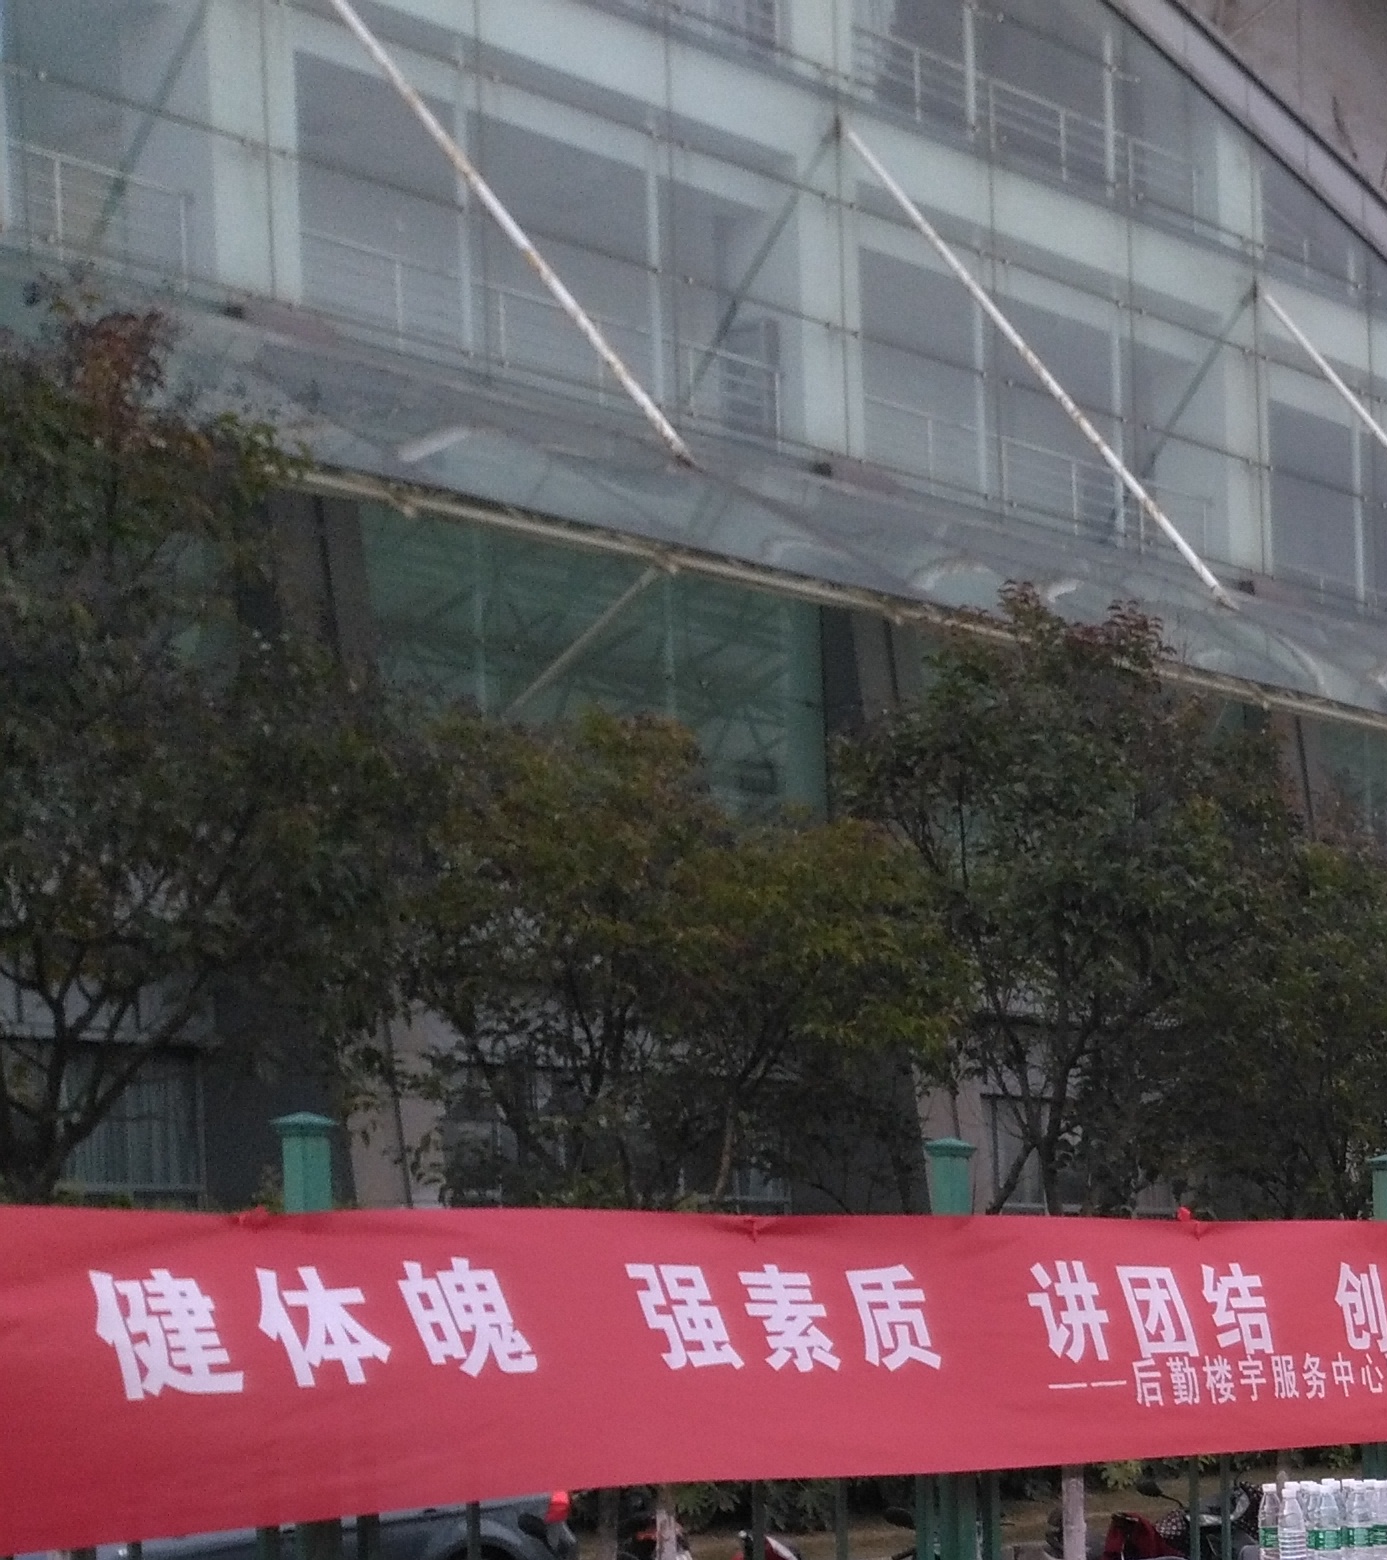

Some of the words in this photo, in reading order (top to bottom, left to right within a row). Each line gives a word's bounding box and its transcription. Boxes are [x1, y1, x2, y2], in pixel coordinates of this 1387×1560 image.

[88, 1256, 539, 1400] 健体魄
[625, 1263, 942, 1373] 强素质
[1027, 1260, 1275, 1363] 讲团结
